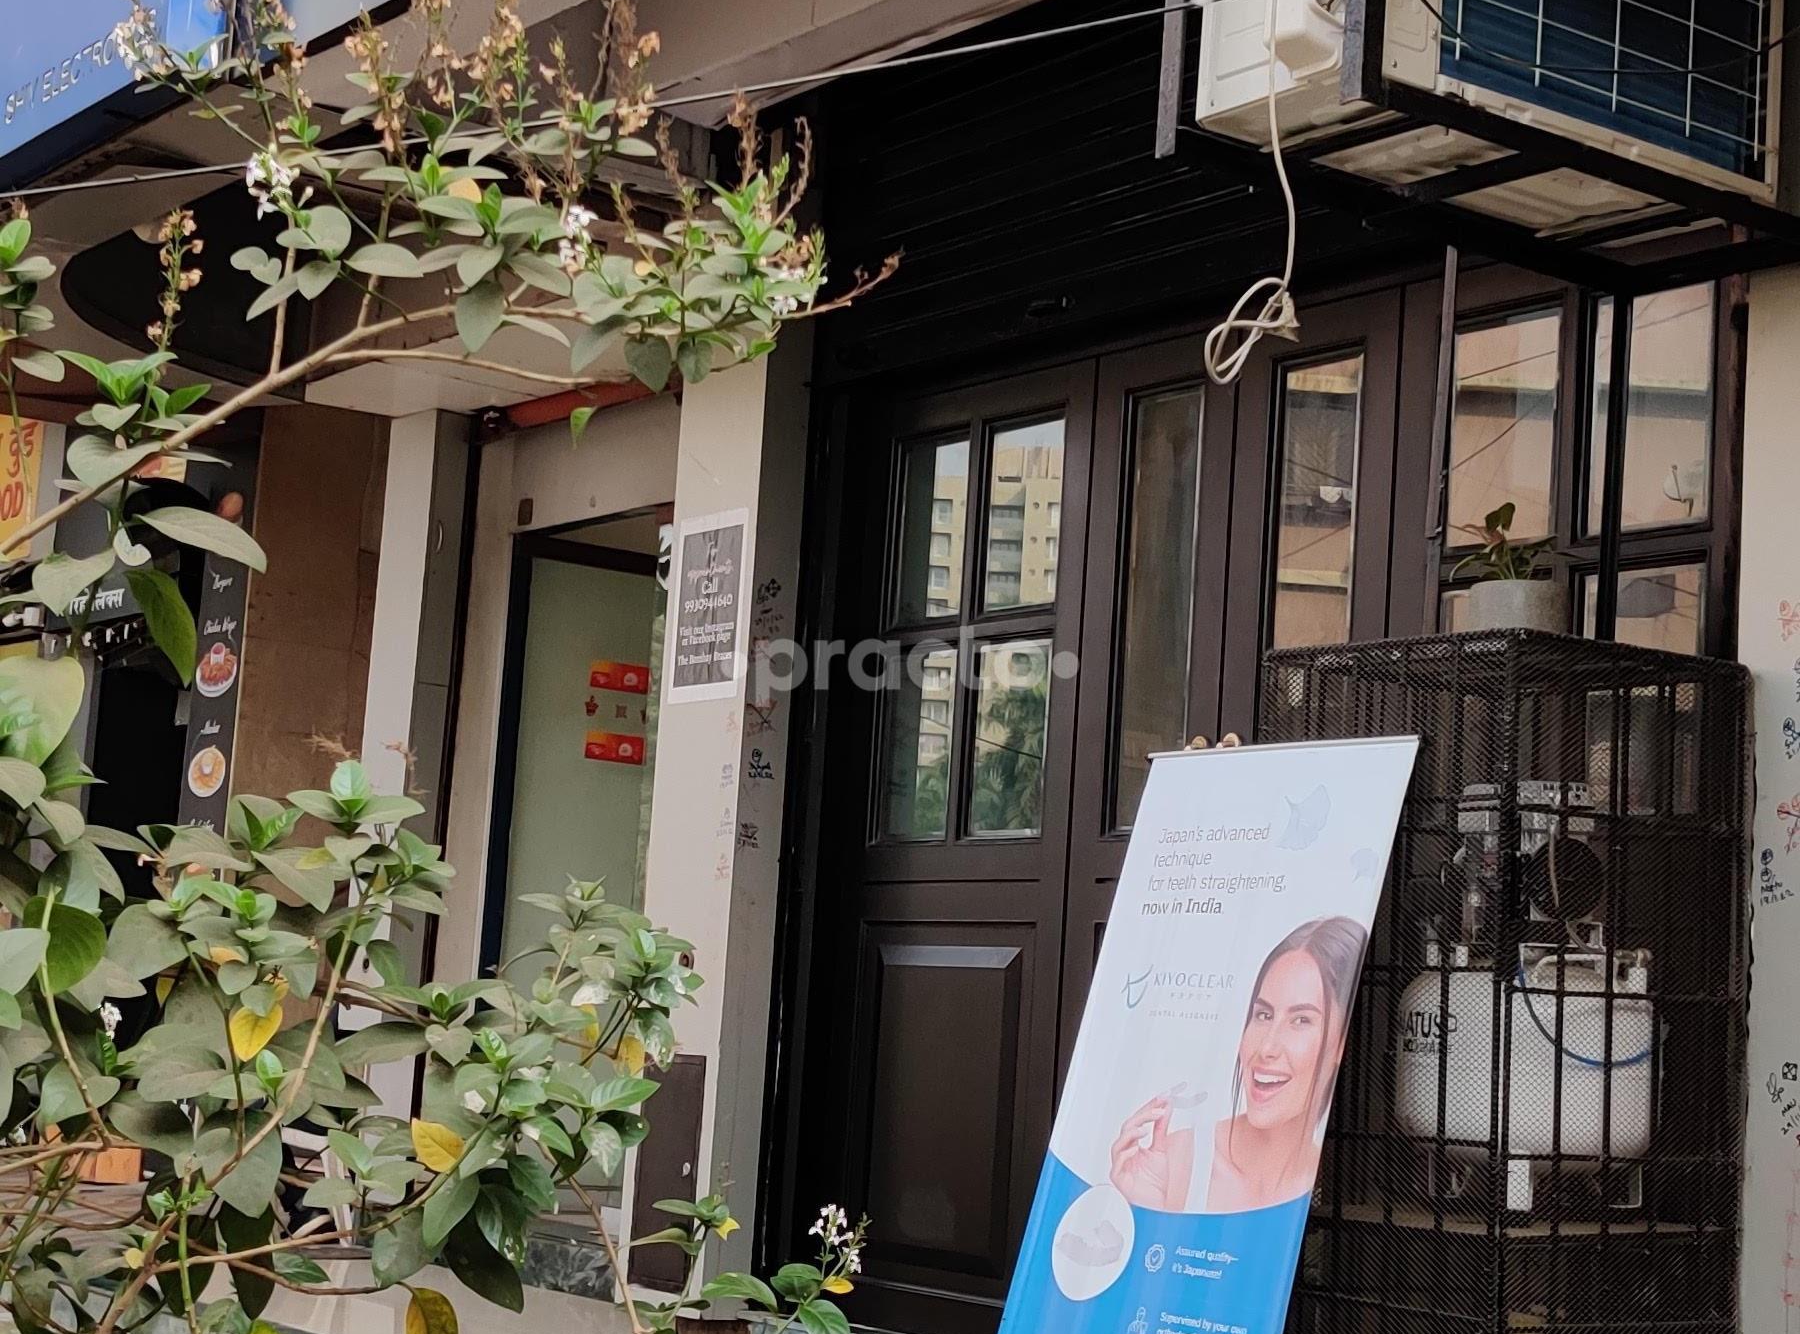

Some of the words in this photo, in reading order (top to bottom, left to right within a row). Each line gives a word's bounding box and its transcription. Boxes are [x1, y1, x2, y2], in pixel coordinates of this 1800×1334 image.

[701, 578, 719, 595] Call
[1158, 826, 1203, 846] Japan's
[1206, 823, 1271, 842] advanced
[1154, 849, 1212, 867] technique
[1148, 875, 1165, 891] for
[1168, 874, 1197, 891] teeth
[1200, 872, 1286, 894] straightening,
[1142, 901, 1169, 915] now
[1171, 898, 1182, 914] in
[1154, 972, 1235, 988] KIYOCLEAR
[1176, 1246, 1206, 1259] Assured
[1160, 1312, 1201, 1327] Supervised
[1202, 1318, 1211, 1331] by
[1212, 1322, 1229, 1333] your
